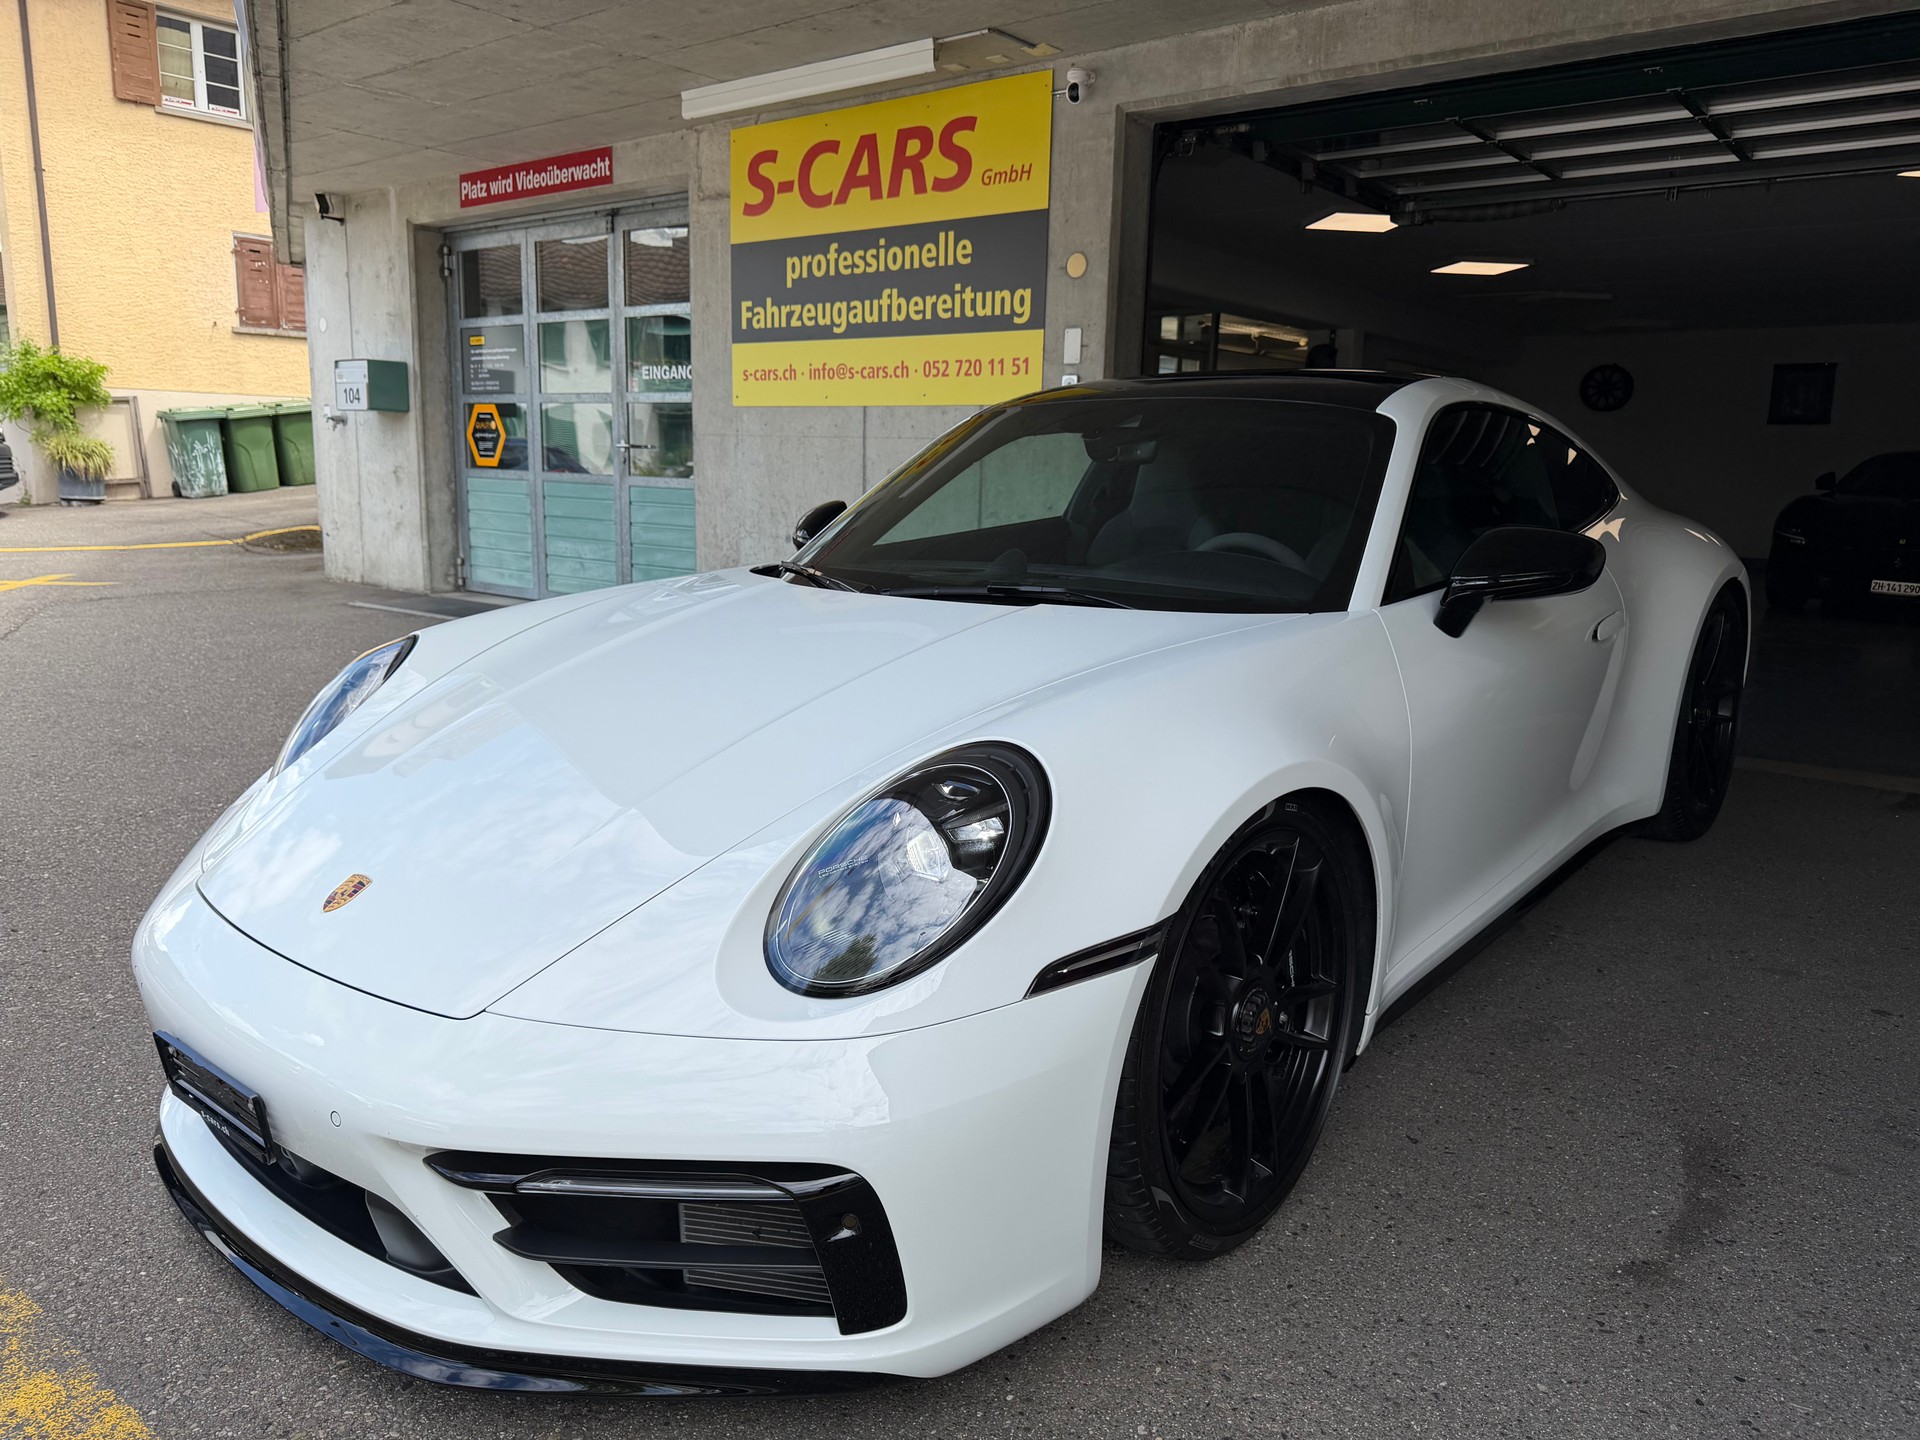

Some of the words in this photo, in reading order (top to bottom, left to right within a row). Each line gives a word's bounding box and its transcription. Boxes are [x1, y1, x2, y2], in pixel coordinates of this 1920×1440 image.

[461, 181, 487, 200] Platz
[489, 174, 513, 195] wird
[515, 157, 610, 191] Videoüberwacht
[742, 116, 978, 217] S-CARS
[981, 163, 1032, 186] GmbH
[786, 231, 972, 288] professionelle
[741, 284, 1031, 333] Fahrzeugaufbereitung
[743, 363, 797, 381] s-cars.ch
[808, 361, 909, 381] info@s-cars.ch
[922, 358, 949, 378] 052
[955, 357, 982, 377] 720
[987, 356, 1005, 376] 11
[1011, 355, 1030, 375] 51
[343, 387, 360, 404] 104
